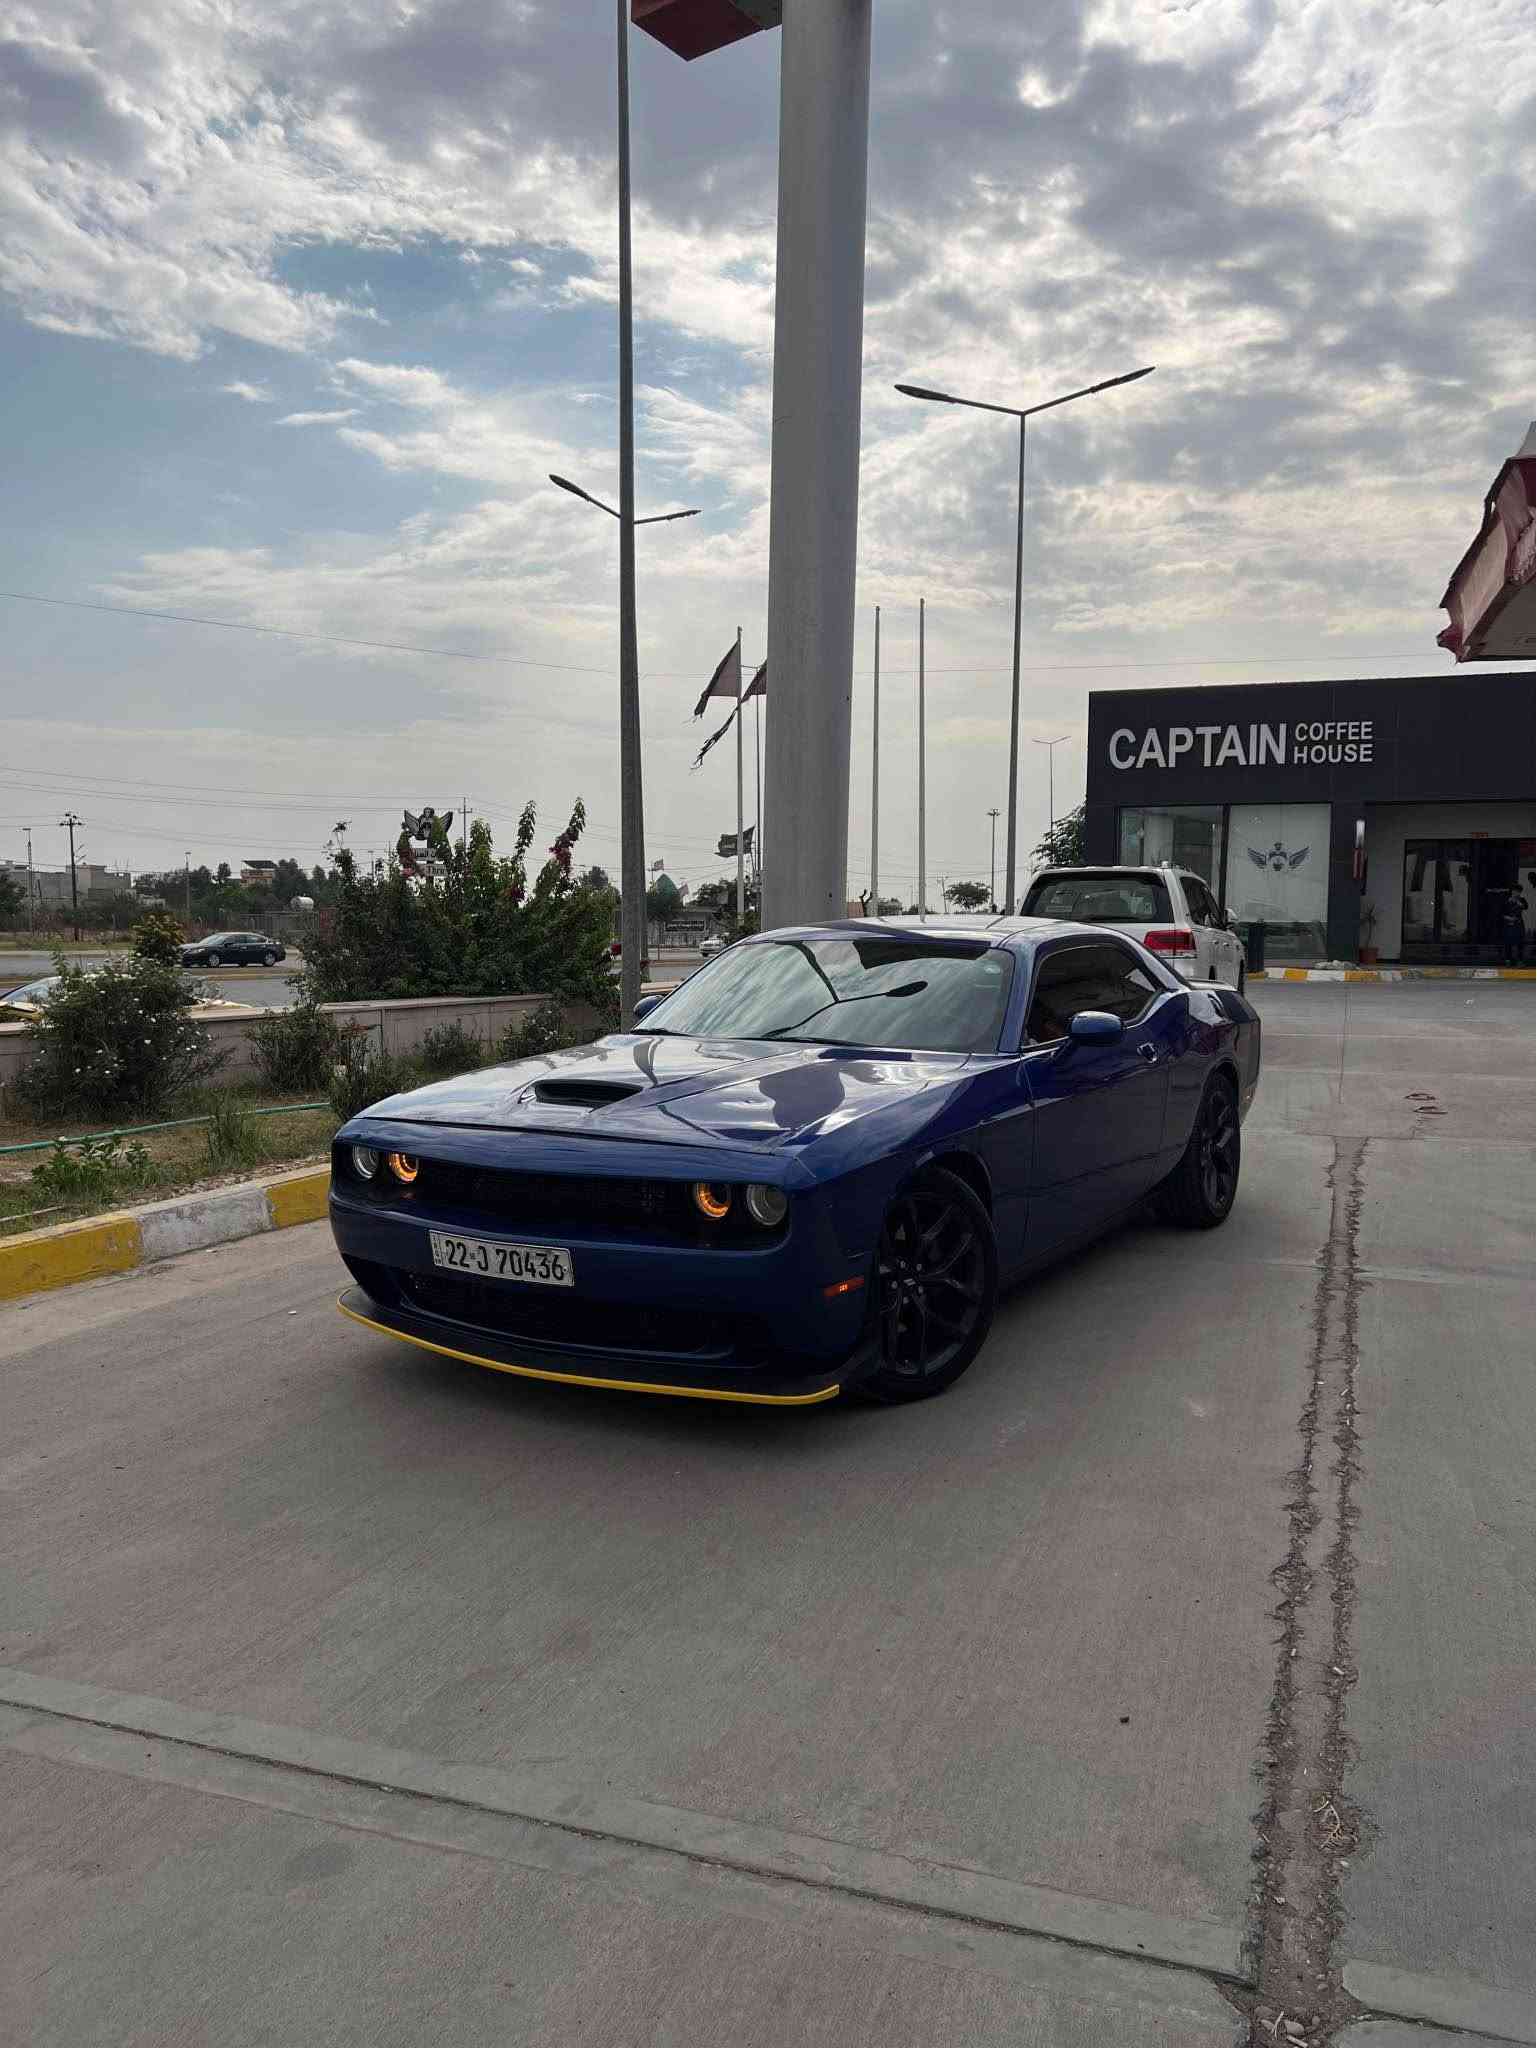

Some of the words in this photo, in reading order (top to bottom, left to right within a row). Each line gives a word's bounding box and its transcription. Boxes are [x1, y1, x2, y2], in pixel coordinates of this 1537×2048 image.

[1295, 721, 1373, 741] COFFEE
[1109, 723, 1287, 769] CAPTAIN
[1293, 744, 1373, 764] HOUSE
[496, 1248, 565, 1281] 70436
